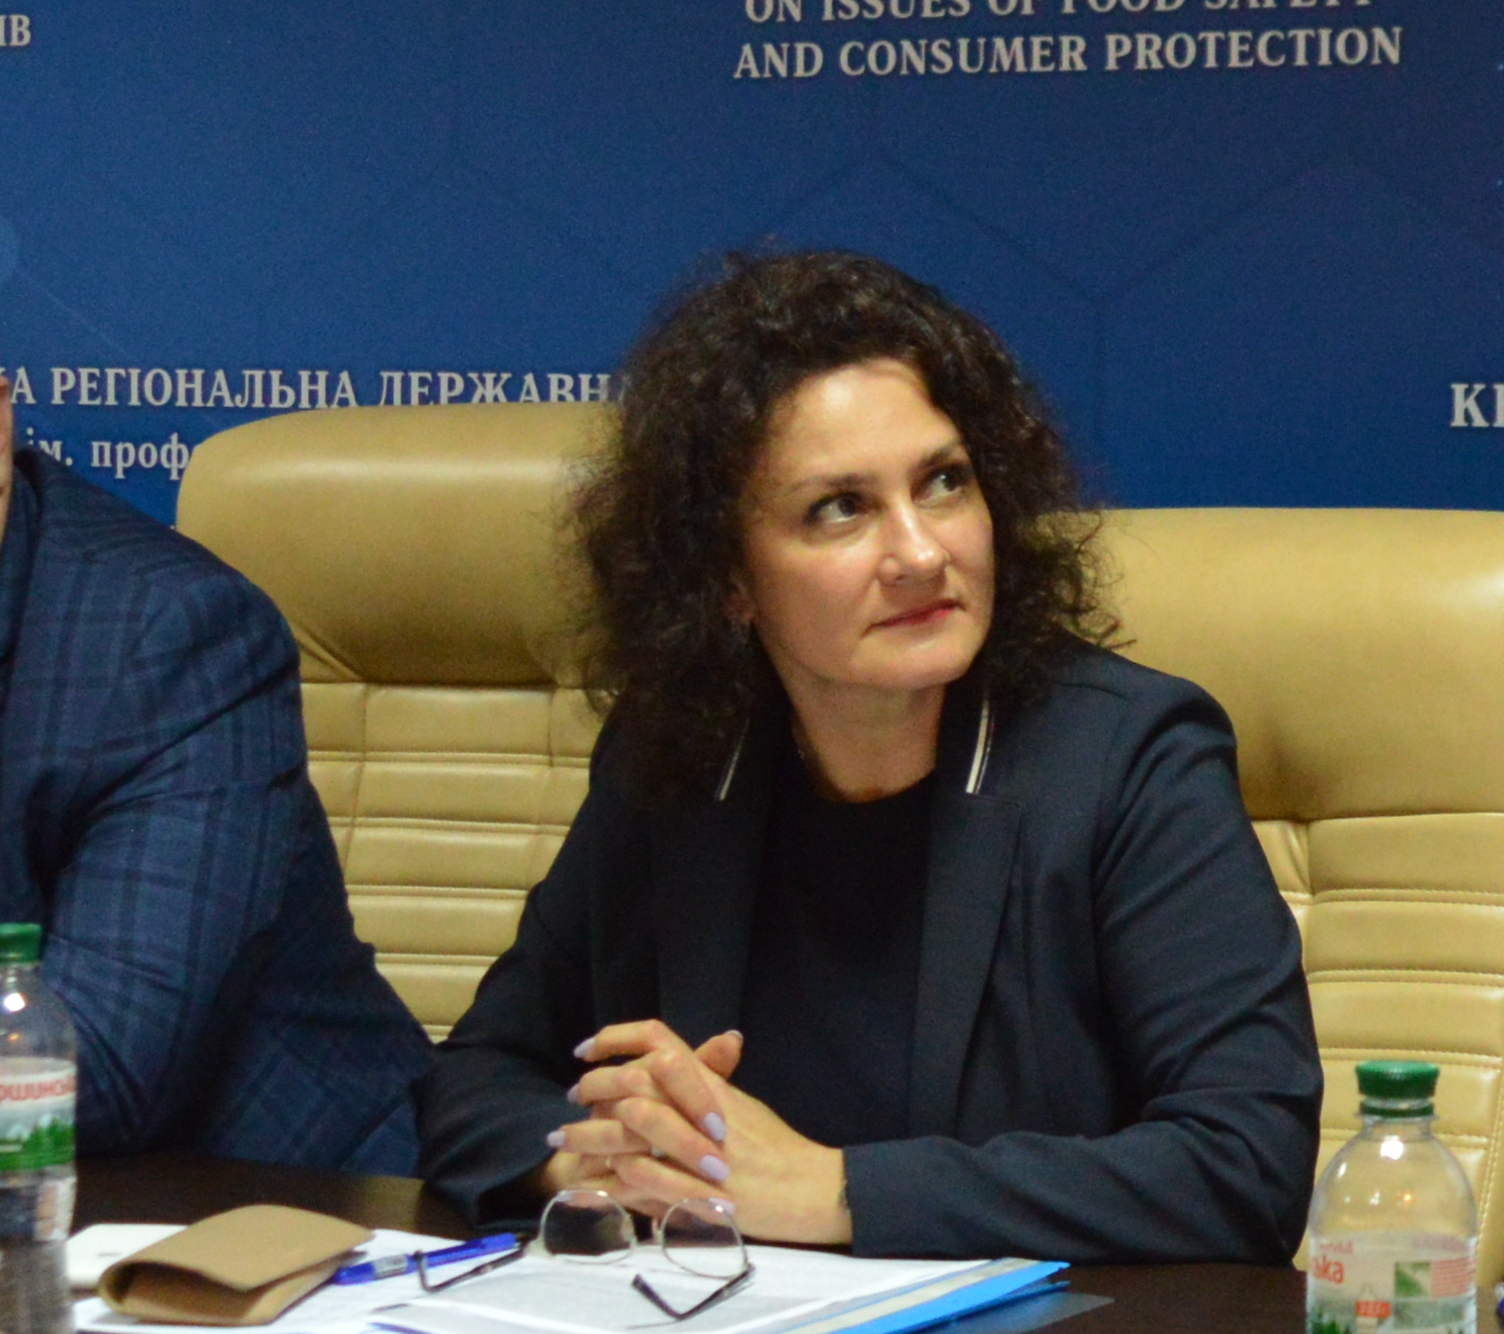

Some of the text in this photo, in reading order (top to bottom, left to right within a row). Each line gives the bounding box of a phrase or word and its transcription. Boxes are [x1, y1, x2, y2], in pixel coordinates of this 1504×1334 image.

[731, 24, 1404, 81] AND CONSUMER PROTECTION
[50, 366, 360, 410] РЕГІОНАЛЬНА
[379, 370, 632, 406] ДЕРЖАВН
